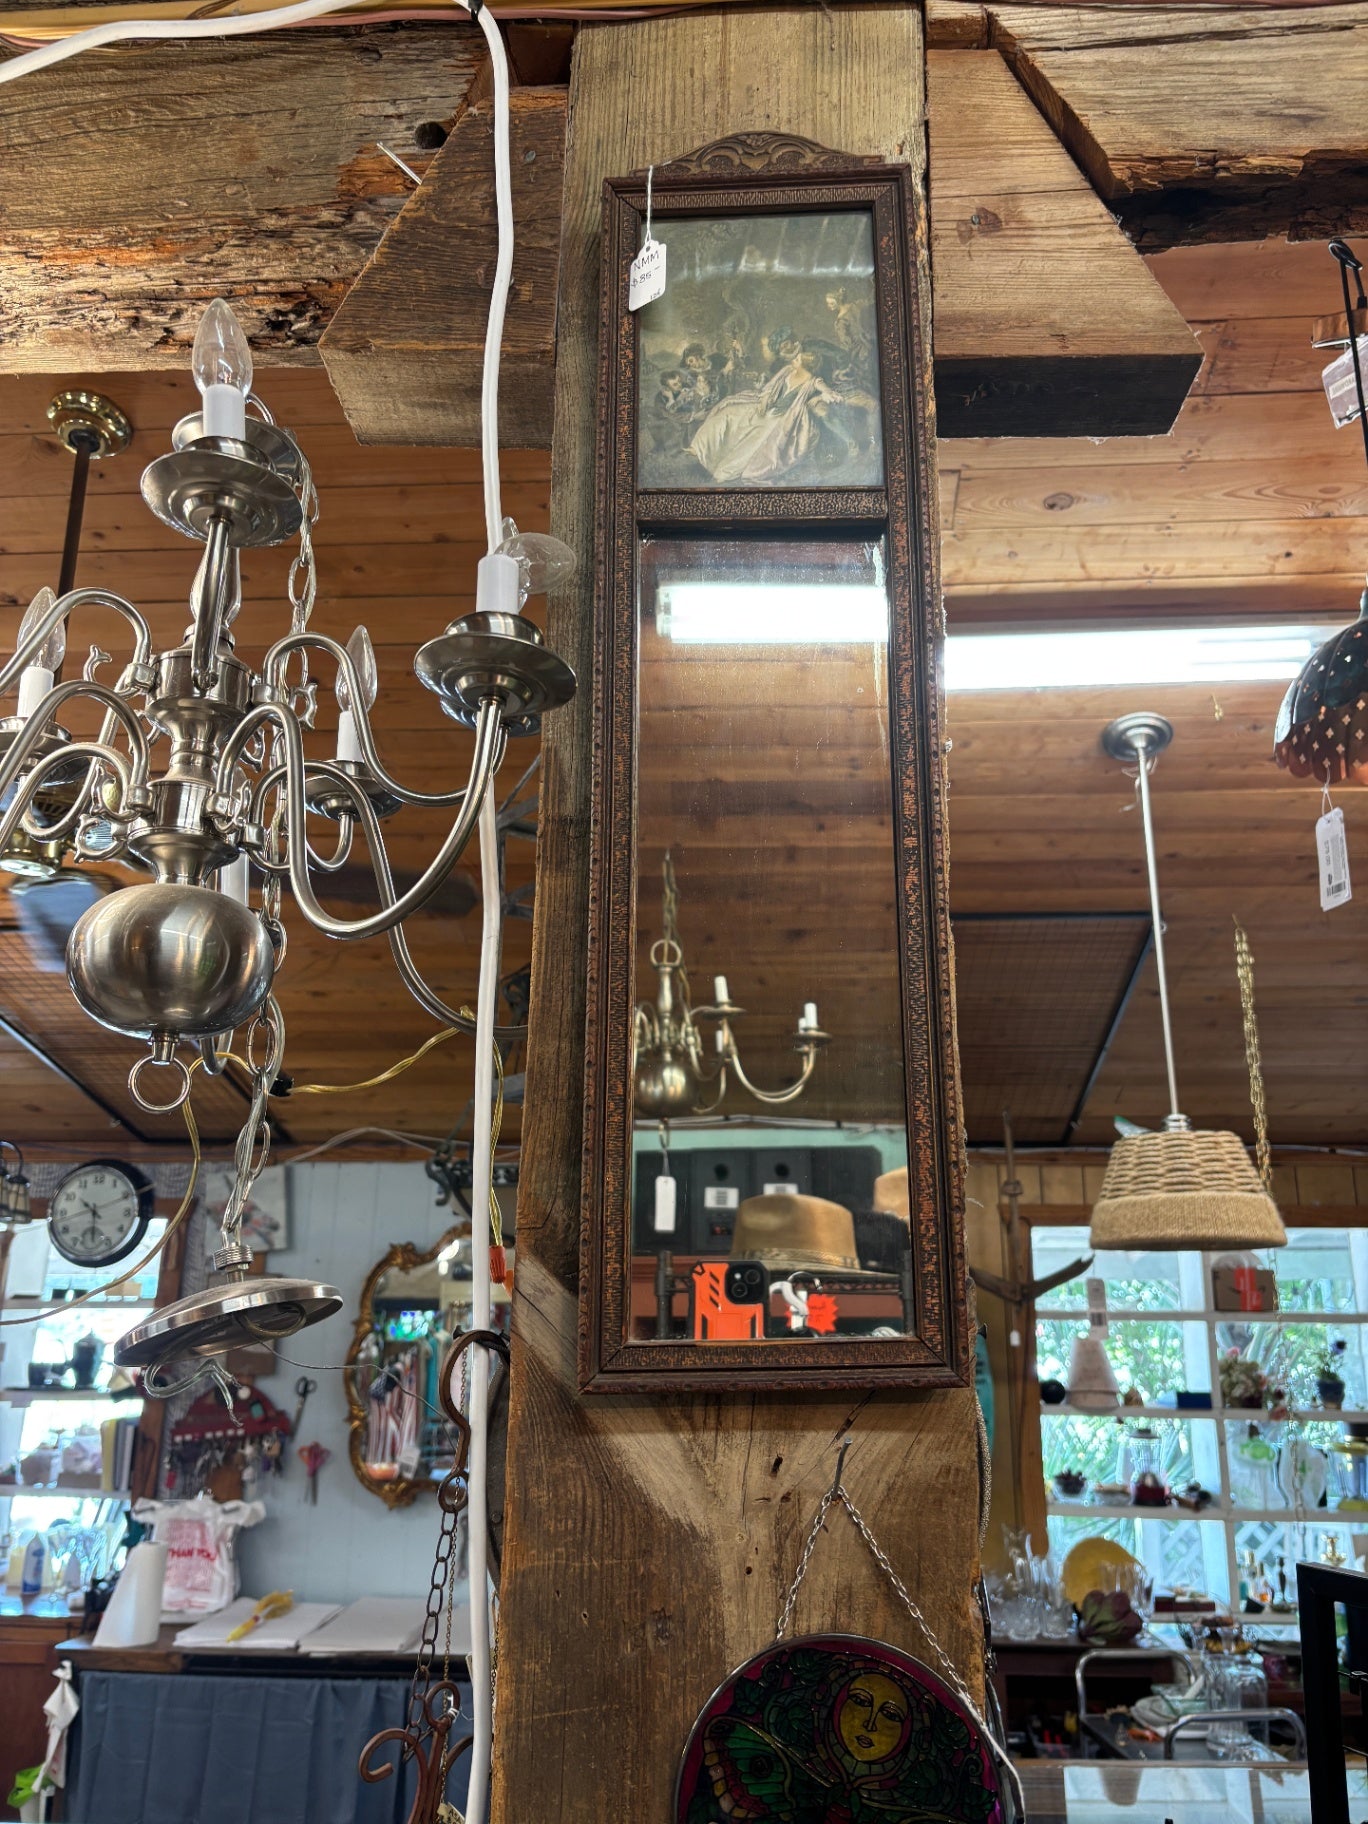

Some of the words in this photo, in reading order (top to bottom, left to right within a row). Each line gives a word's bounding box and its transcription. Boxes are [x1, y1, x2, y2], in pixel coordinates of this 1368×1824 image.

[78, 1179, 87, 1189] 11
[93, 1175, 105, 1185] 12
[65, 1191, 76, 1201] 10
